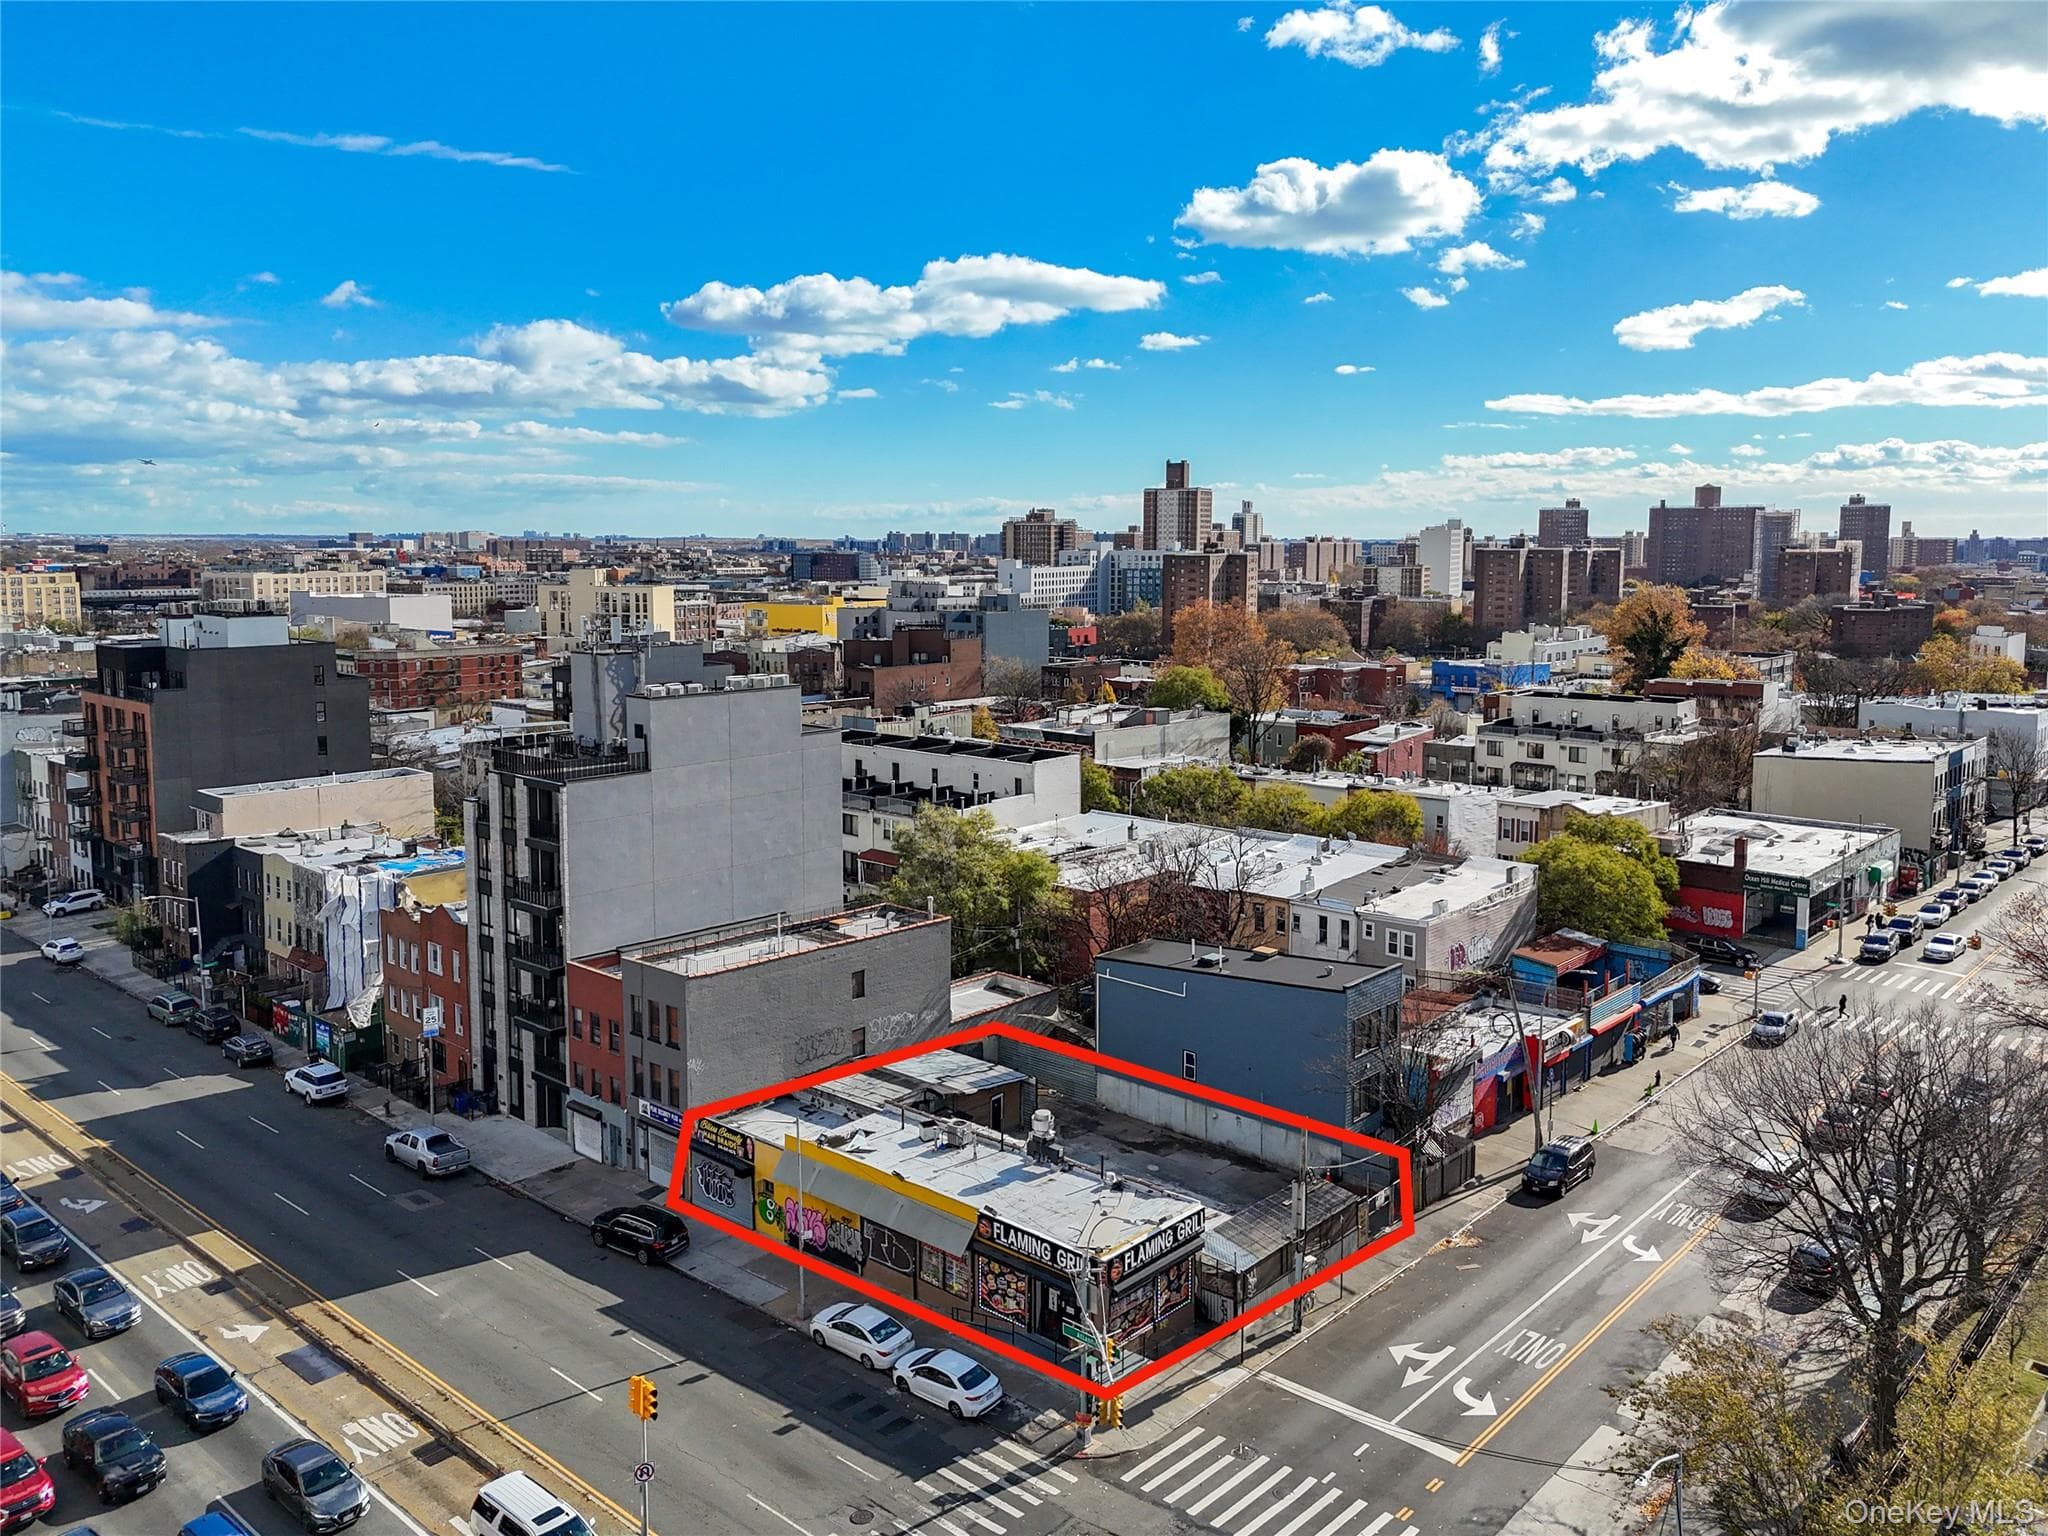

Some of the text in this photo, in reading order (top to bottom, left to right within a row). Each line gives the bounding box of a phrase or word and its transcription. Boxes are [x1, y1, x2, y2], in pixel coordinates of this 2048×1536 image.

[1744, 873, 1808, 889] Ocean Hill Medical Center
[425, 1016, 437, 1024] 25
[717, 1135, 737, 1150] BRAIDS
[718, 1127, 743, 1145] Beauty
[6, 1153, 73, 1177] ONLY
[1651, 1200, 1711, 1230] ONLY
[993, 1222, 1051, 1260] FLAMING
[1124, 1229, 1174, 1272] FLAMING
[1177, 1211, 1206, 1240] GRILL
[141, 1261, 213, 1299] ONLY
[1494, 1328, 1567, 1369] ONLY
[340, 1412, 418, 1464] ONLY
